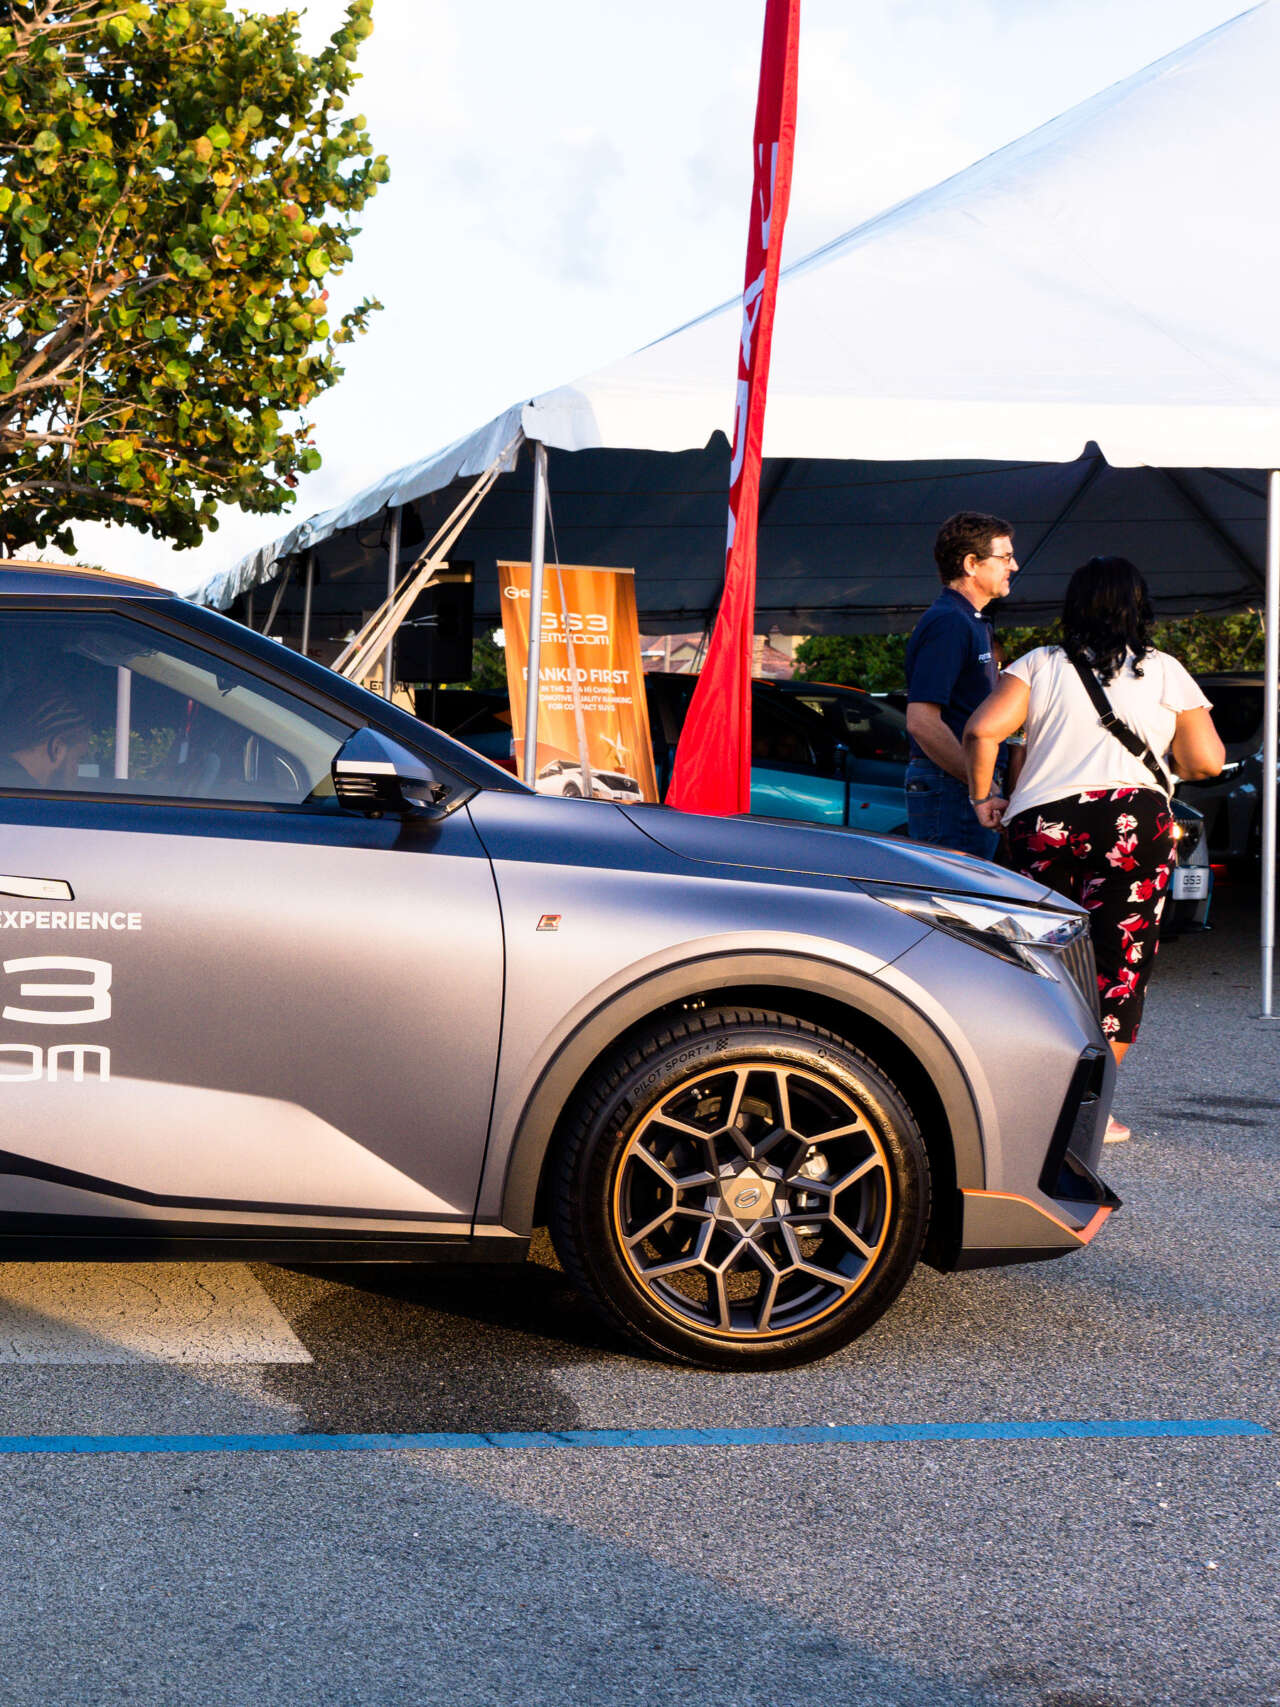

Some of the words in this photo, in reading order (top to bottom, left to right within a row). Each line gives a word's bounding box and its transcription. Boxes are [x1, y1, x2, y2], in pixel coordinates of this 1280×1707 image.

[520, 588, 549, 599] GC
[540, 612, 608, 632] GS3
[589, 669, 629, 684] FIRST
[633, 1068, 663, 1097] PILOT
[665, 1046, 704, 1072] SPORT
